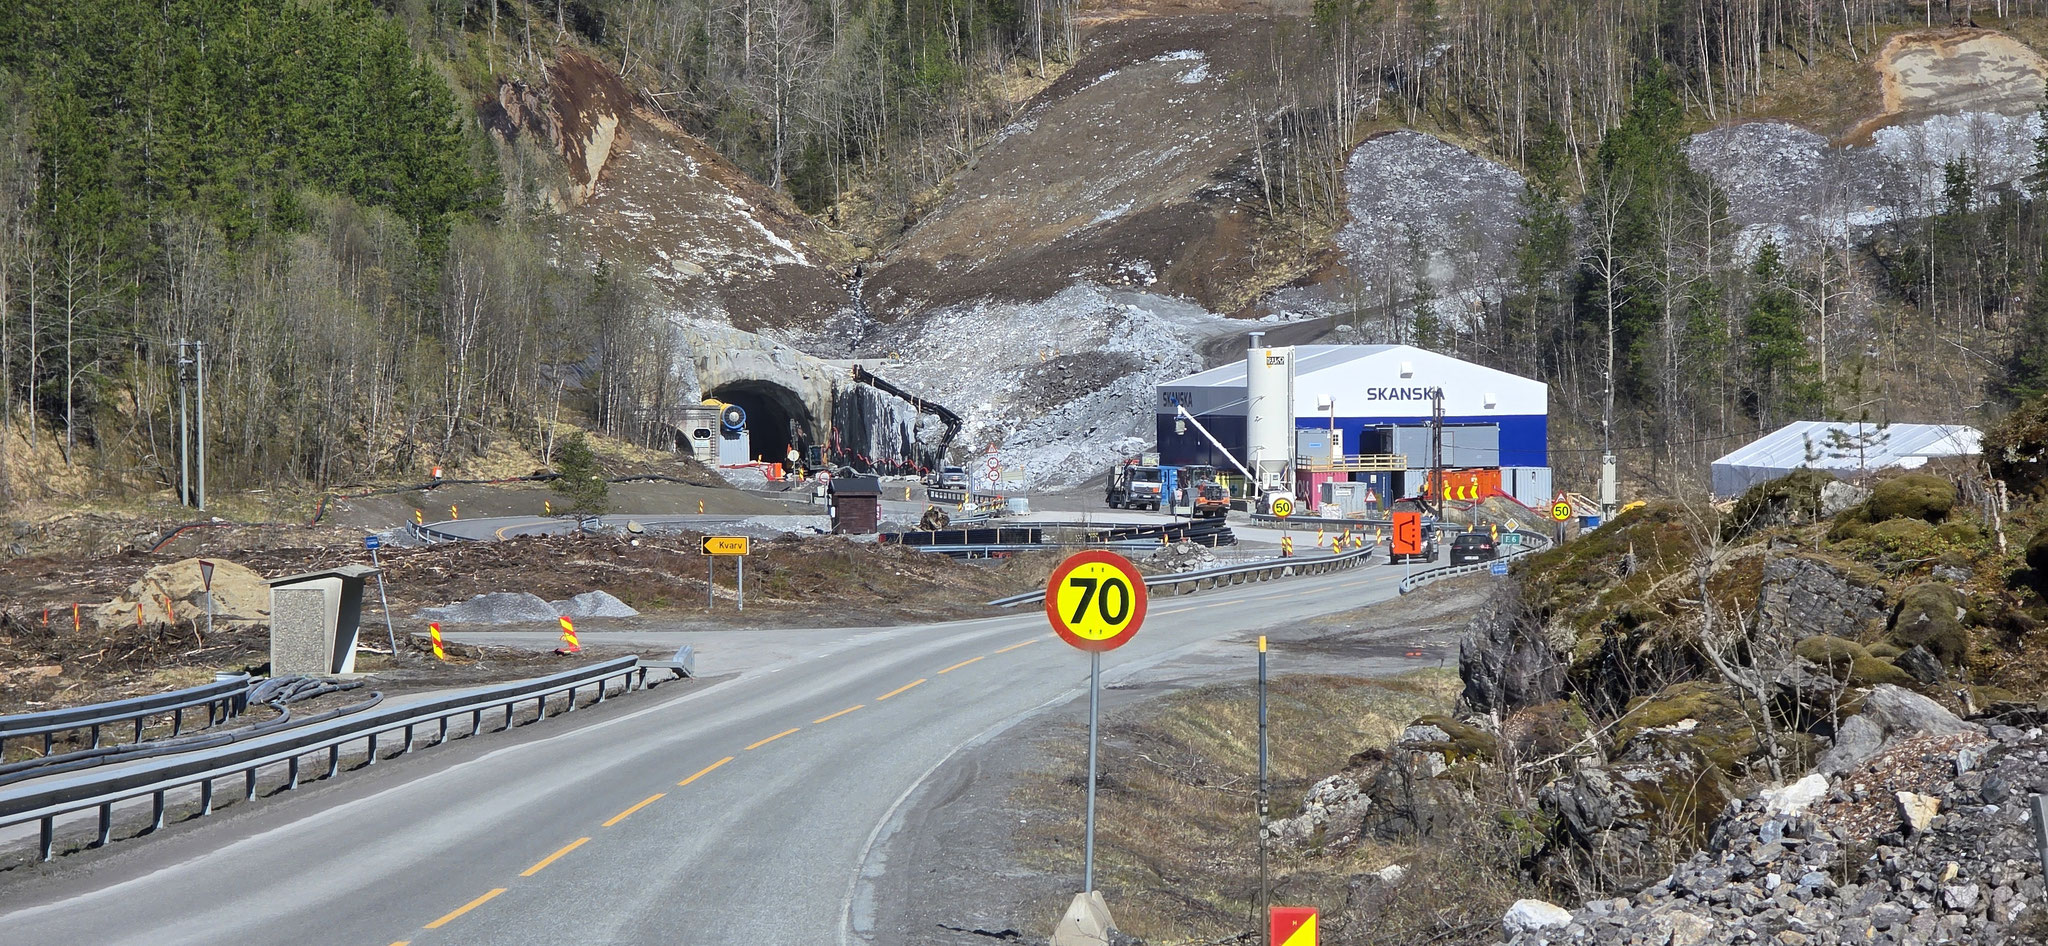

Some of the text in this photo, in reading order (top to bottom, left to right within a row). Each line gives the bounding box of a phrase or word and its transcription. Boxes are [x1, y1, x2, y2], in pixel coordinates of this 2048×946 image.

[1367, 387, 1445, 401] SKANSKA
[1276, 502, 1290, 513] 50
[1555, 506, 1569, 516] 50
[718, 541, 743, 550] Kvarv
[1070, 577, 1129, 625] 70
